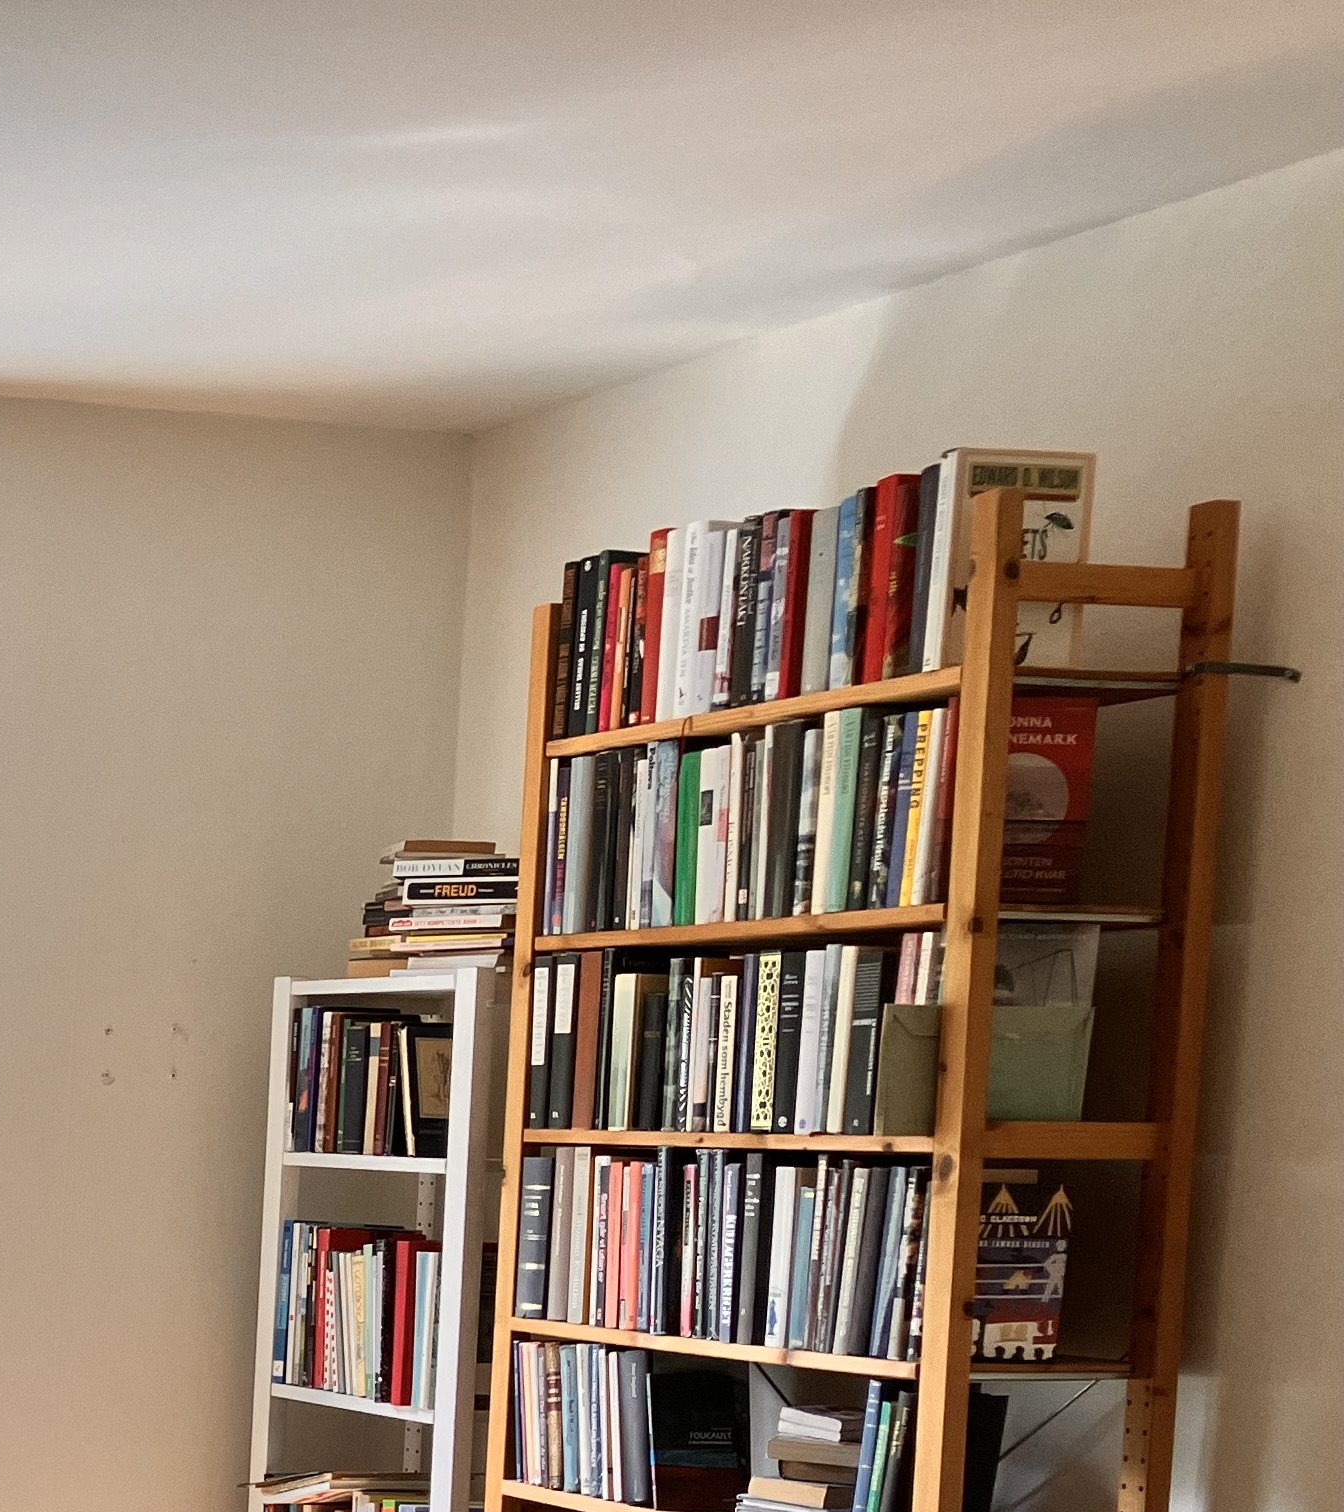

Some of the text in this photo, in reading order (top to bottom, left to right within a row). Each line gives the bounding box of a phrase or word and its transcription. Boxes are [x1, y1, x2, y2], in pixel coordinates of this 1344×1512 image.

[647, 747, 657, 790] Poltava
[910, 723, 928, 809] PREPPING
[434, 884, 476, 897] FREUD
[716, 1001, 733, 1127] Staden som hembygd
